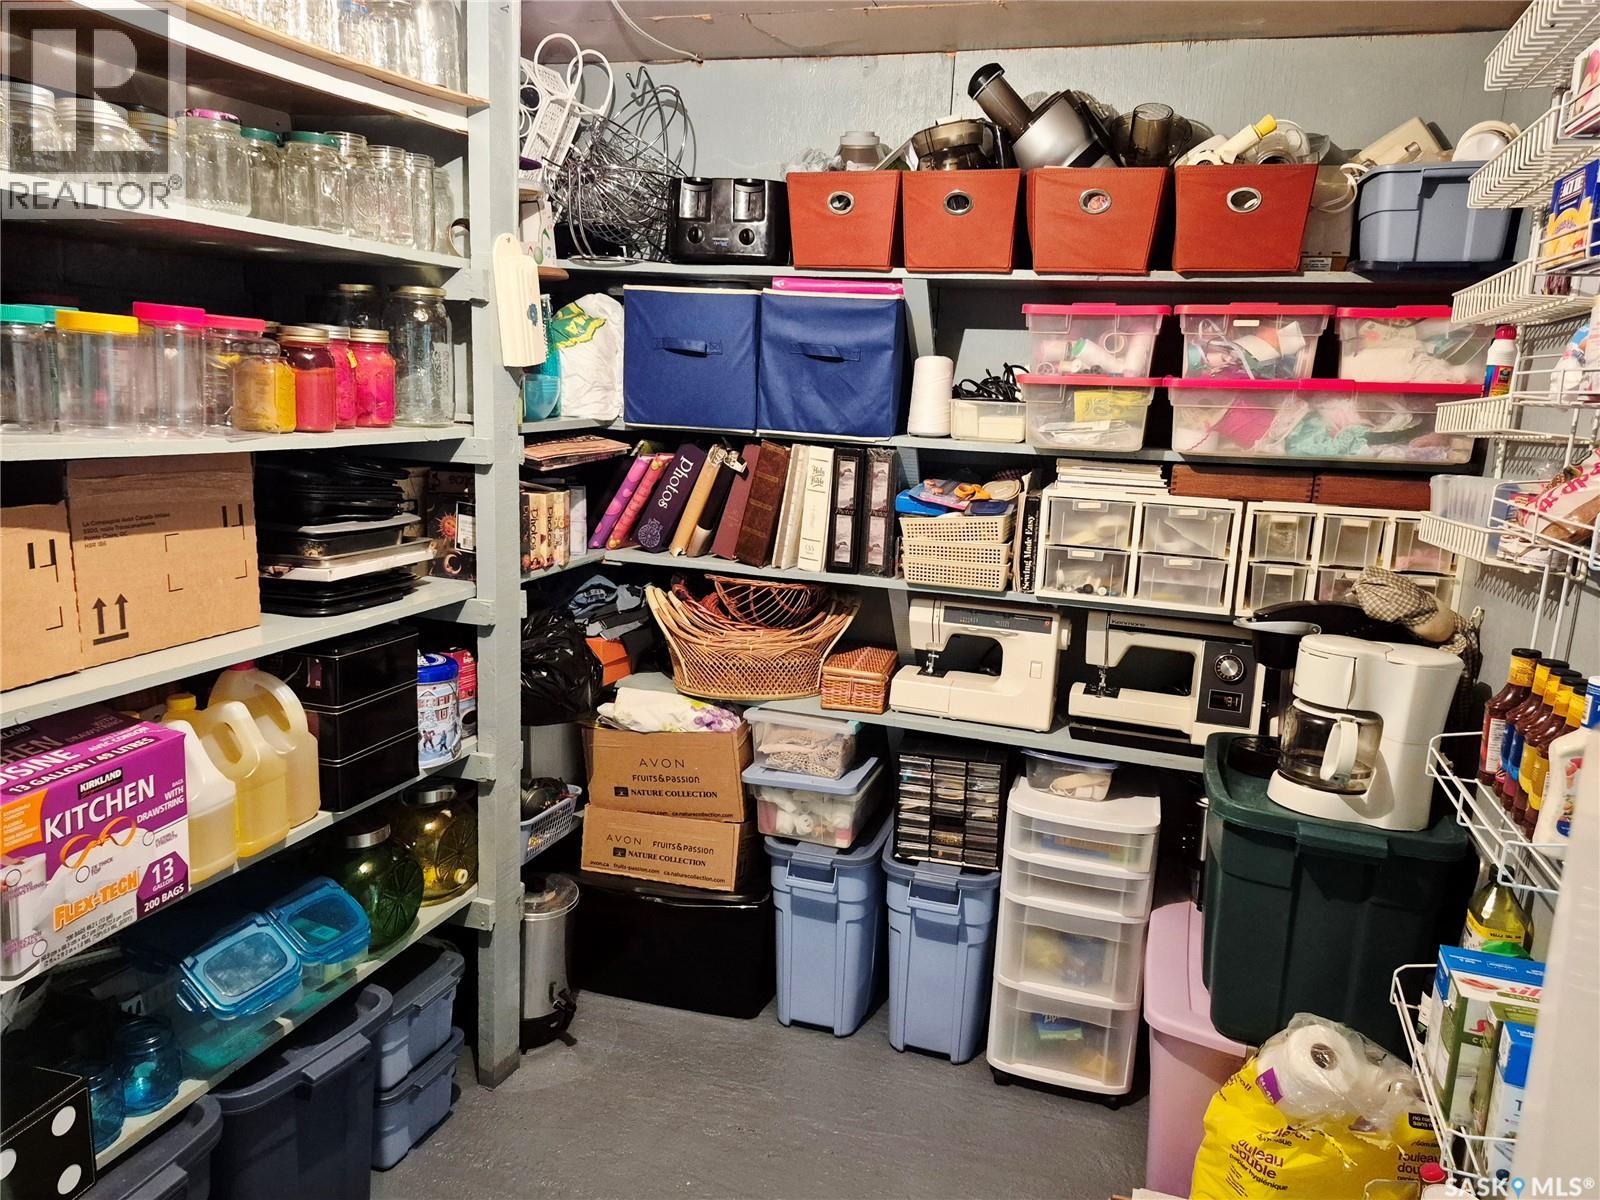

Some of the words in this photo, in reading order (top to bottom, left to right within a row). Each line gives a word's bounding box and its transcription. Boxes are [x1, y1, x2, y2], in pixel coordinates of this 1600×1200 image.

[657, 455, 695, 509] Photos
[1025, 515, 1036, 535] Easy
[1023, 536, 1033, 559] Made
[1022, 560, 1033, 590] Sewing
[0, 725, 31, 741] LAND
[9, 784, 31, 793] 13
[31, 759, 86, 788] GALLON
[96, 751, 113, 762] 49
[111, 737, 155, 759] LITRES
[639, 758, 686, 769] AVON
[79, 769, 122, 793] KIRKLAND
[164, 785, 184, 800] WITH
[630, 788, 664, 797] NATURE
[664, 789, 718, 799] COLLECTION
[44, 774, 156, 844] KITCHEN
[136, 795, 185, 824] DRAWSTRING
[606, 833, 642, 846] AVON
[627, 850, 658, 861] NATURE
[658, 855, 707, 867] COLLECTION
[151, 857, 175, 884] 13
[152, 877, 175, 892] GALLON
[53, 869, 140, 933] FLEX-TECH
[143, 898, 161, 913] 200
[161, 883, 185, 903] BAGS
[1231, 1143, 1277, 1179] double
[1396, 1162, 1420, 1175] dou
